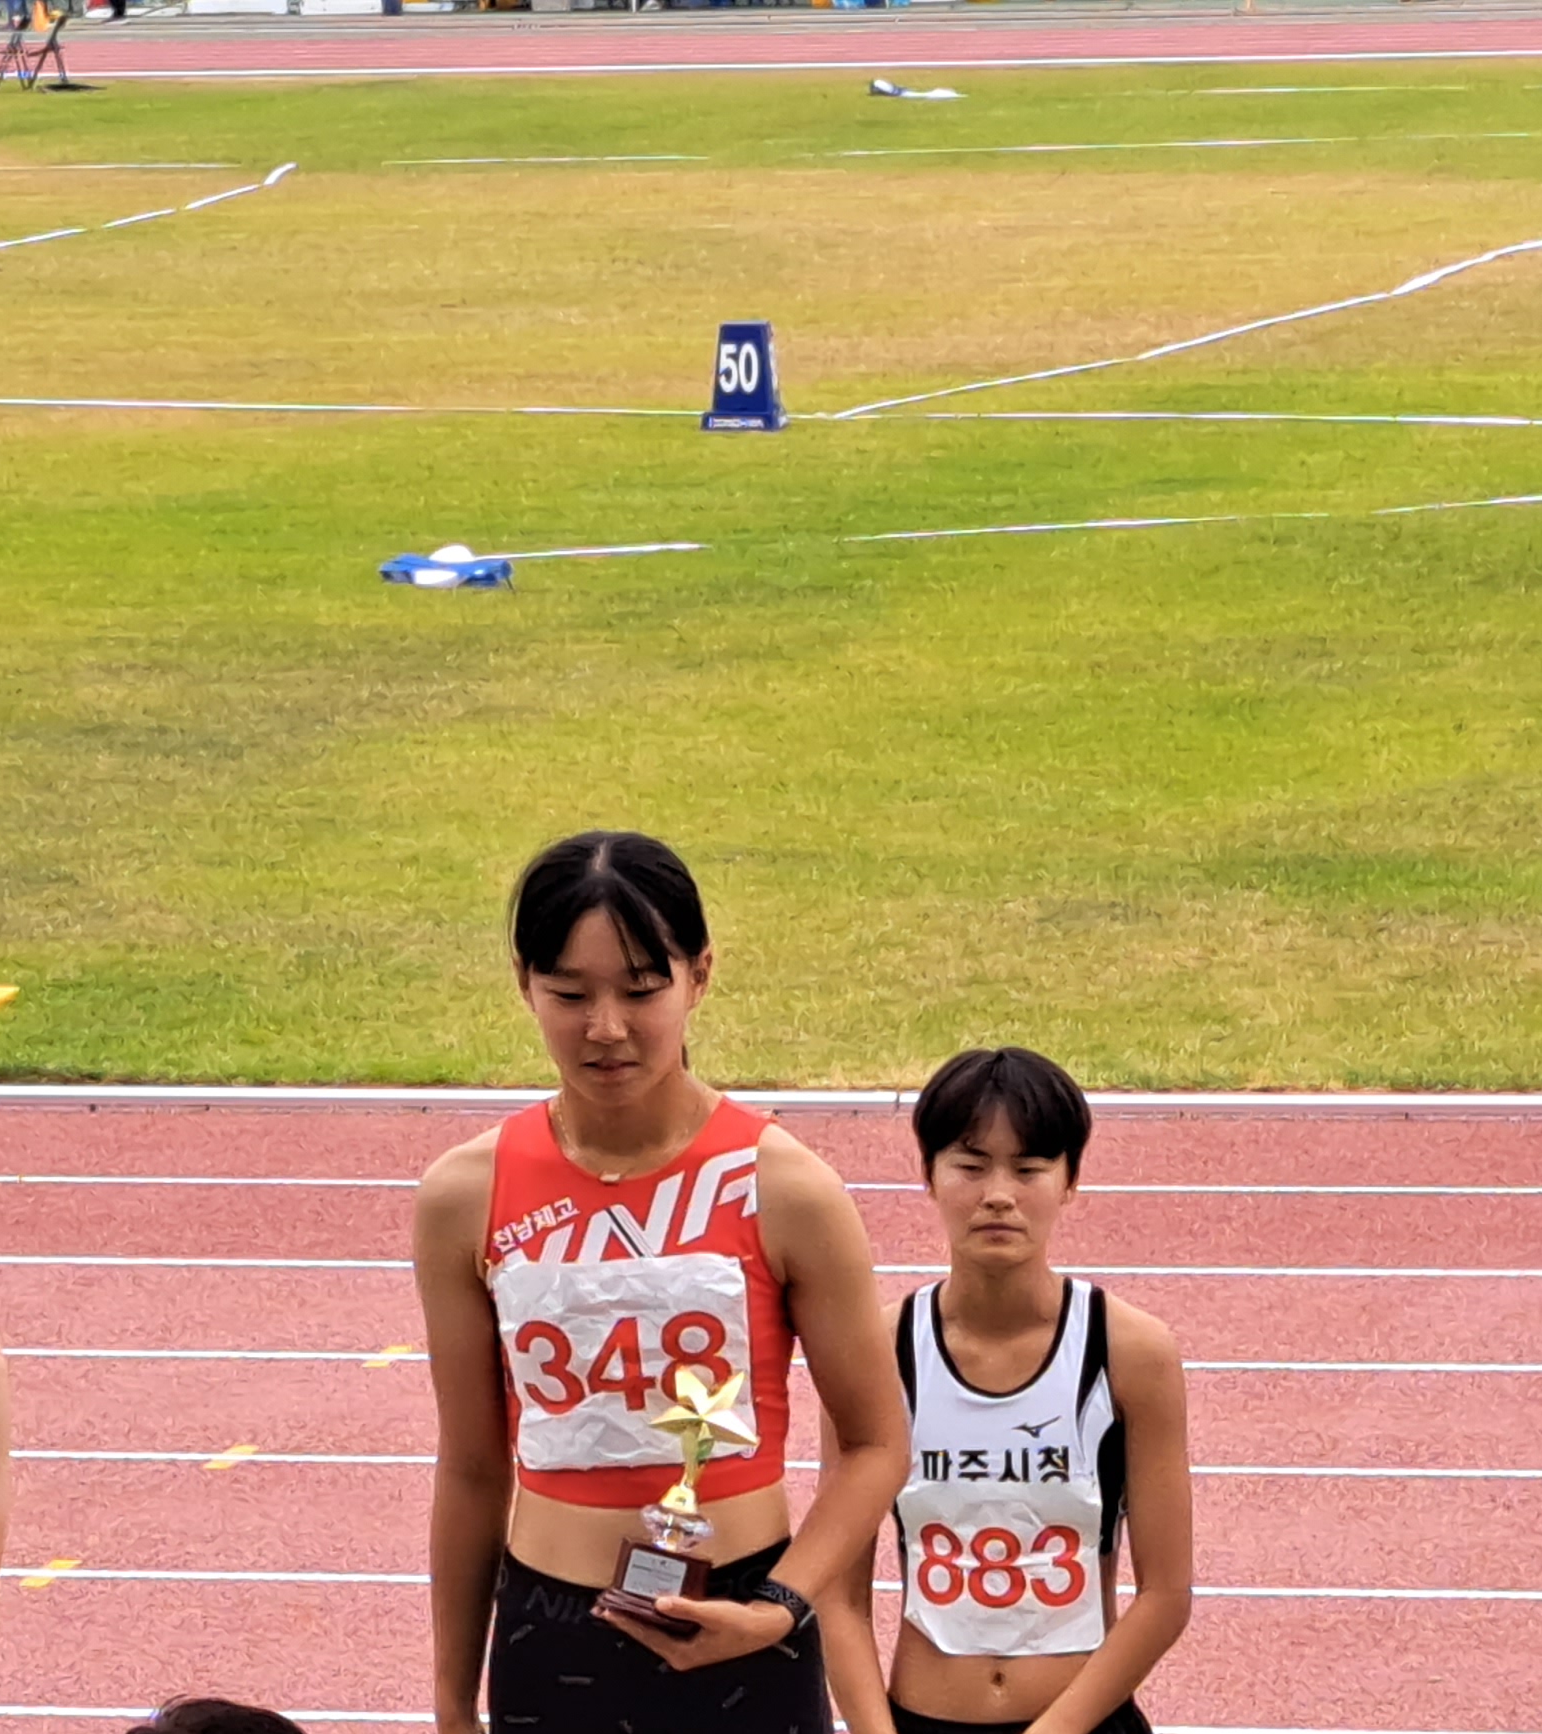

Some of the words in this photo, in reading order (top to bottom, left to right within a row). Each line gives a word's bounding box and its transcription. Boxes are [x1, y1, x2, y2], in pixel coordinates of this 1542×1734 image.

[719, 343, 759, 393] 50
[514, 1311, 731, 1415] 348
[917, 1522, 1086, 1608] 883
